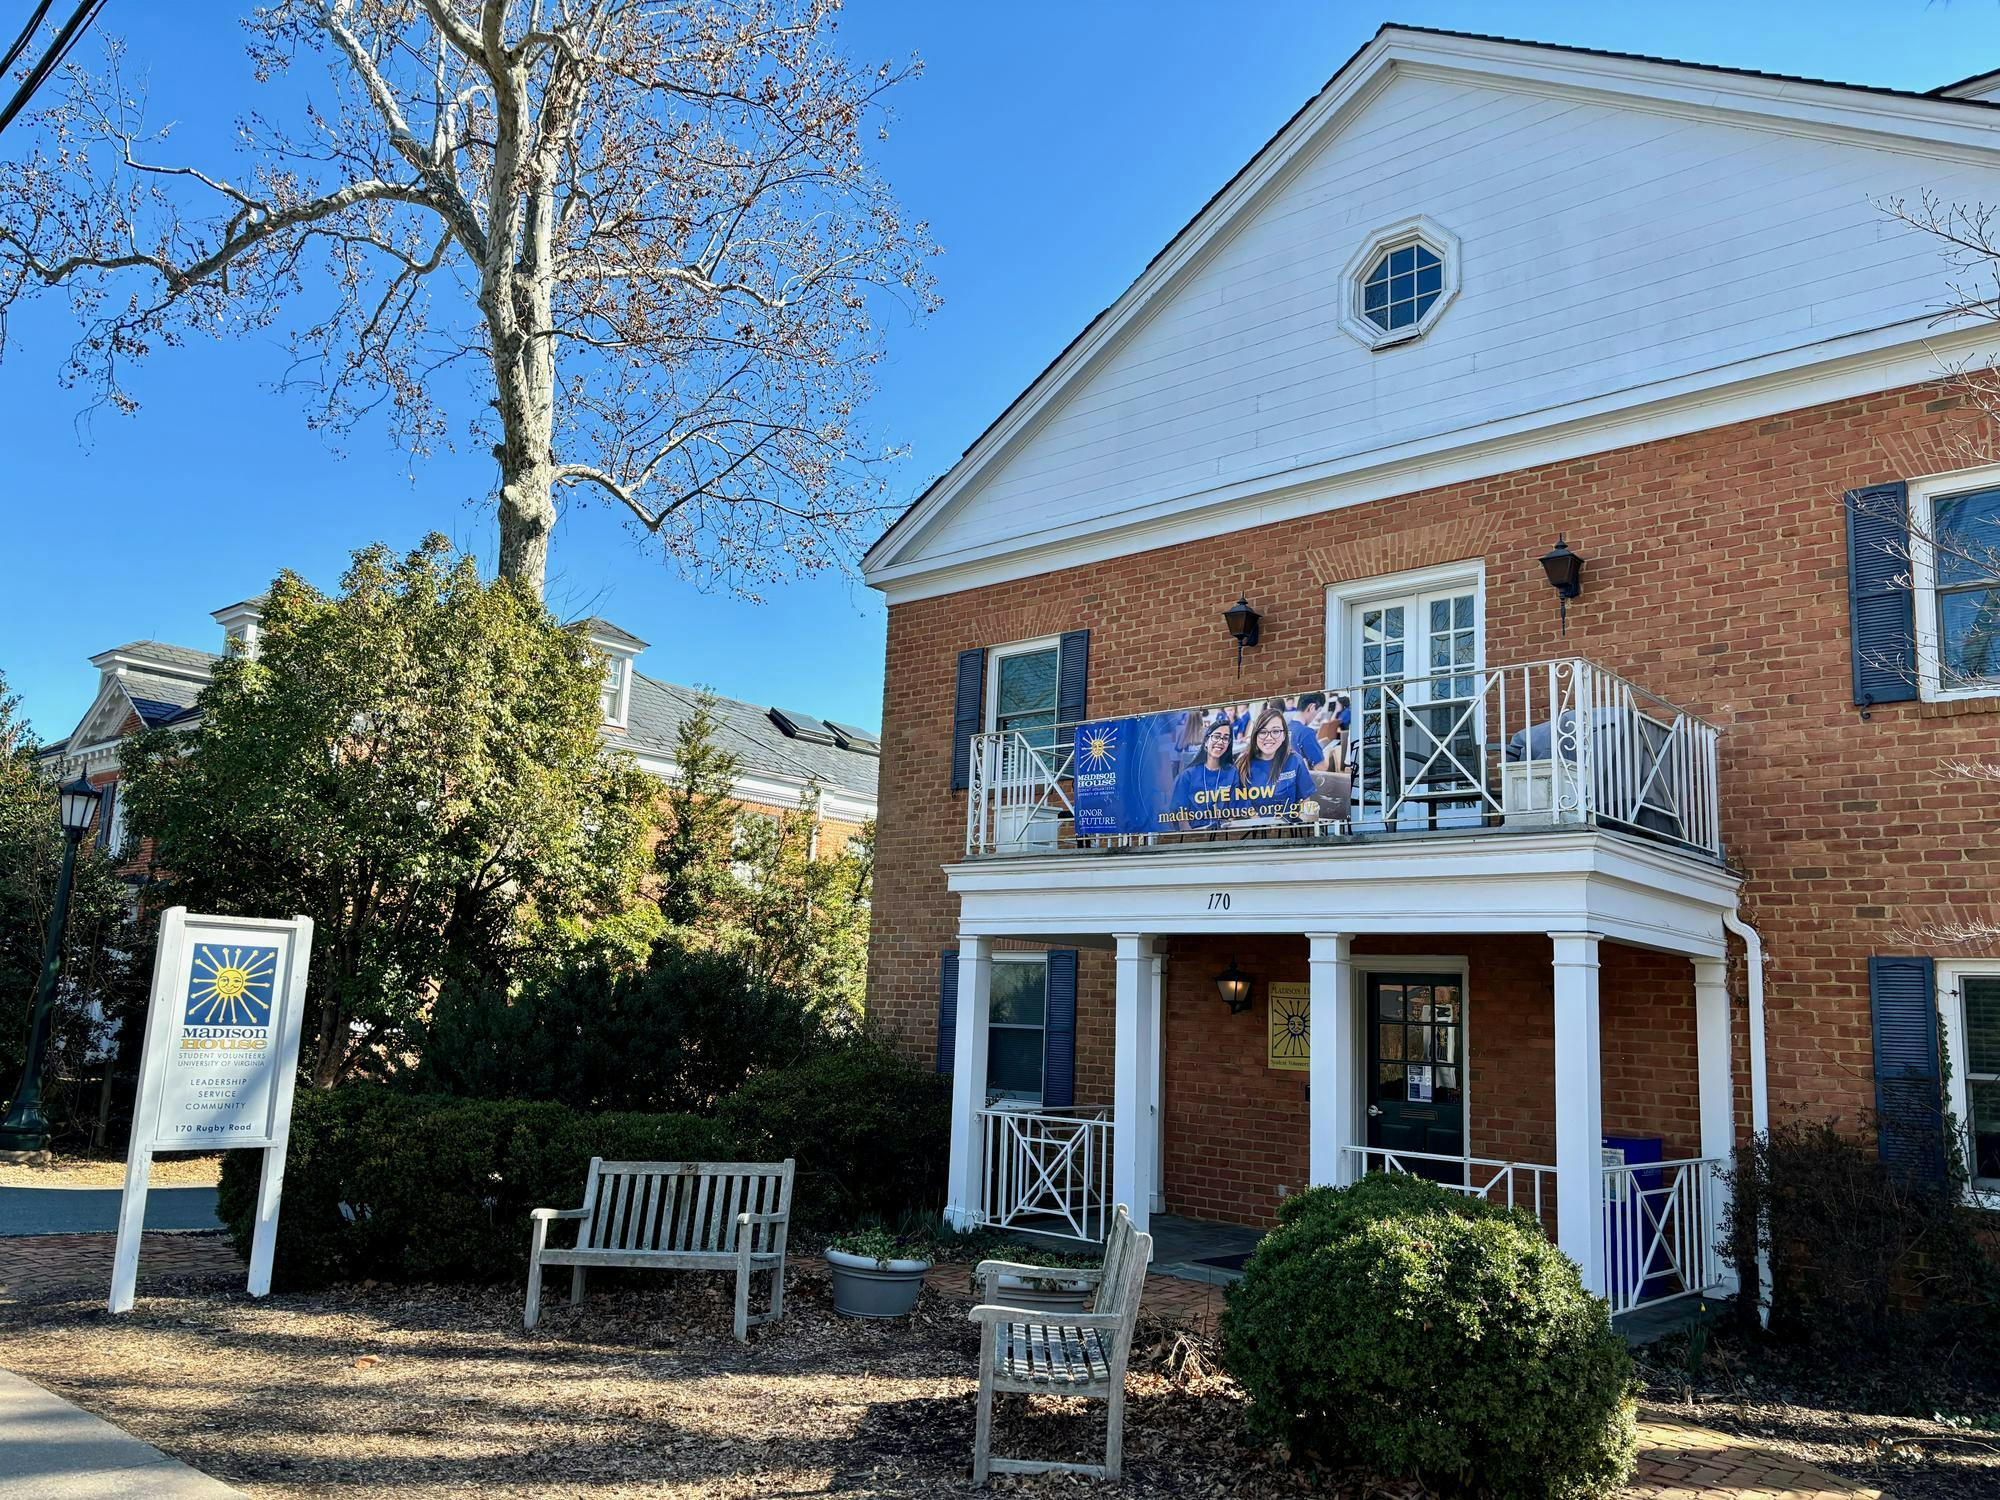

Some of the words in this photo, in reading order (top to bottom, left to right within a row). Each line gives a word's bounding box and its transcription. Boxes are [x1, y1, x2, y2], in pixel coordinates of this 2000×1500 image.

[1194, 787, 1231, 804] GIVE
[1235, 784, 1276, 801] NOW
[1078, 808, 1103, 817] ONOR
[1158, 798, 1320, 824] madisonhouse.org/give
[1207, 893, 1231, 910] 170
[190, 1078, 247, 1086] LEADERSHIP
[198, 1090, 237, 1098] SERVICE
[185, 1102, 247, 1110] COMMUNITY
[175, 1124, 192, 1132] 170
[196, 1124, 225, 1133] Rugby
[228, 1123, 252, 1131] Road
